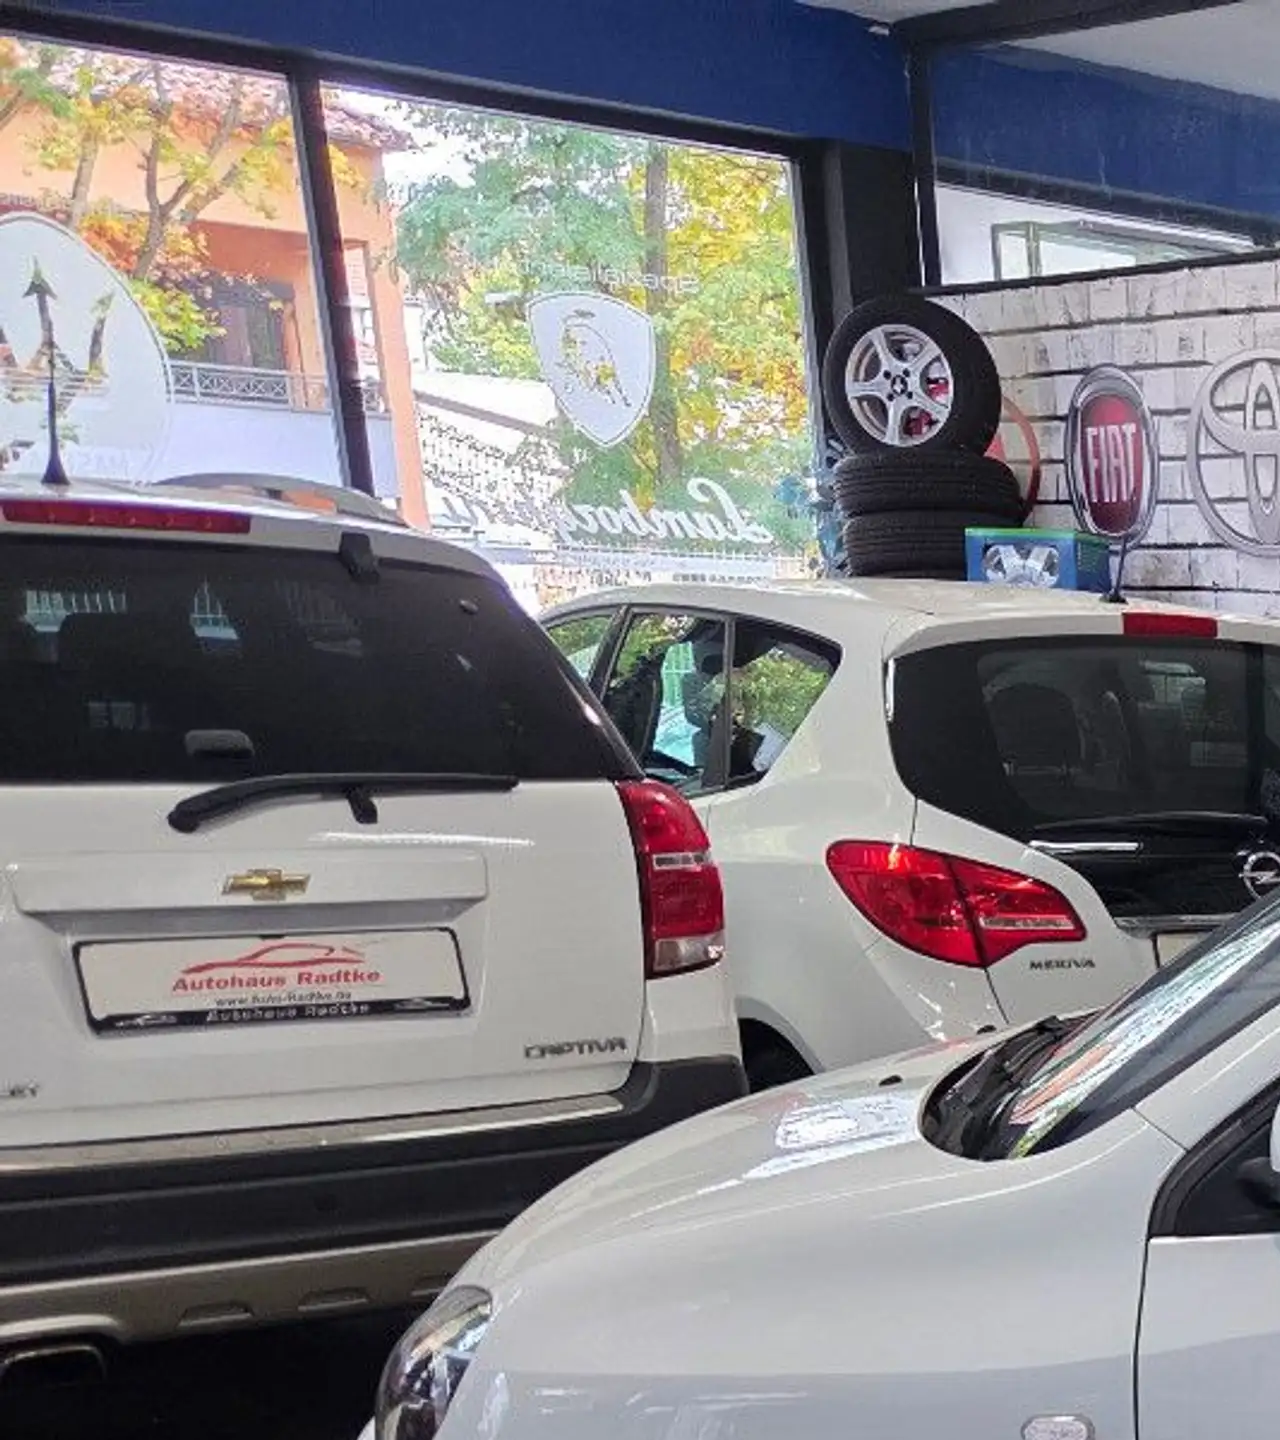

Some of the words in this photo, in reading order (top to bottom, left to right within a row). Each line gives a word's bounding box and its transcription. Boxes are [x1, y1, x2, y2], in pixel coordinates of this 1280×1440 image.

[1086, 422, 1137, 503] FIAT
[172, 974, 287, 993] Autohaus
[297, 968, 381, 986] Radtke
